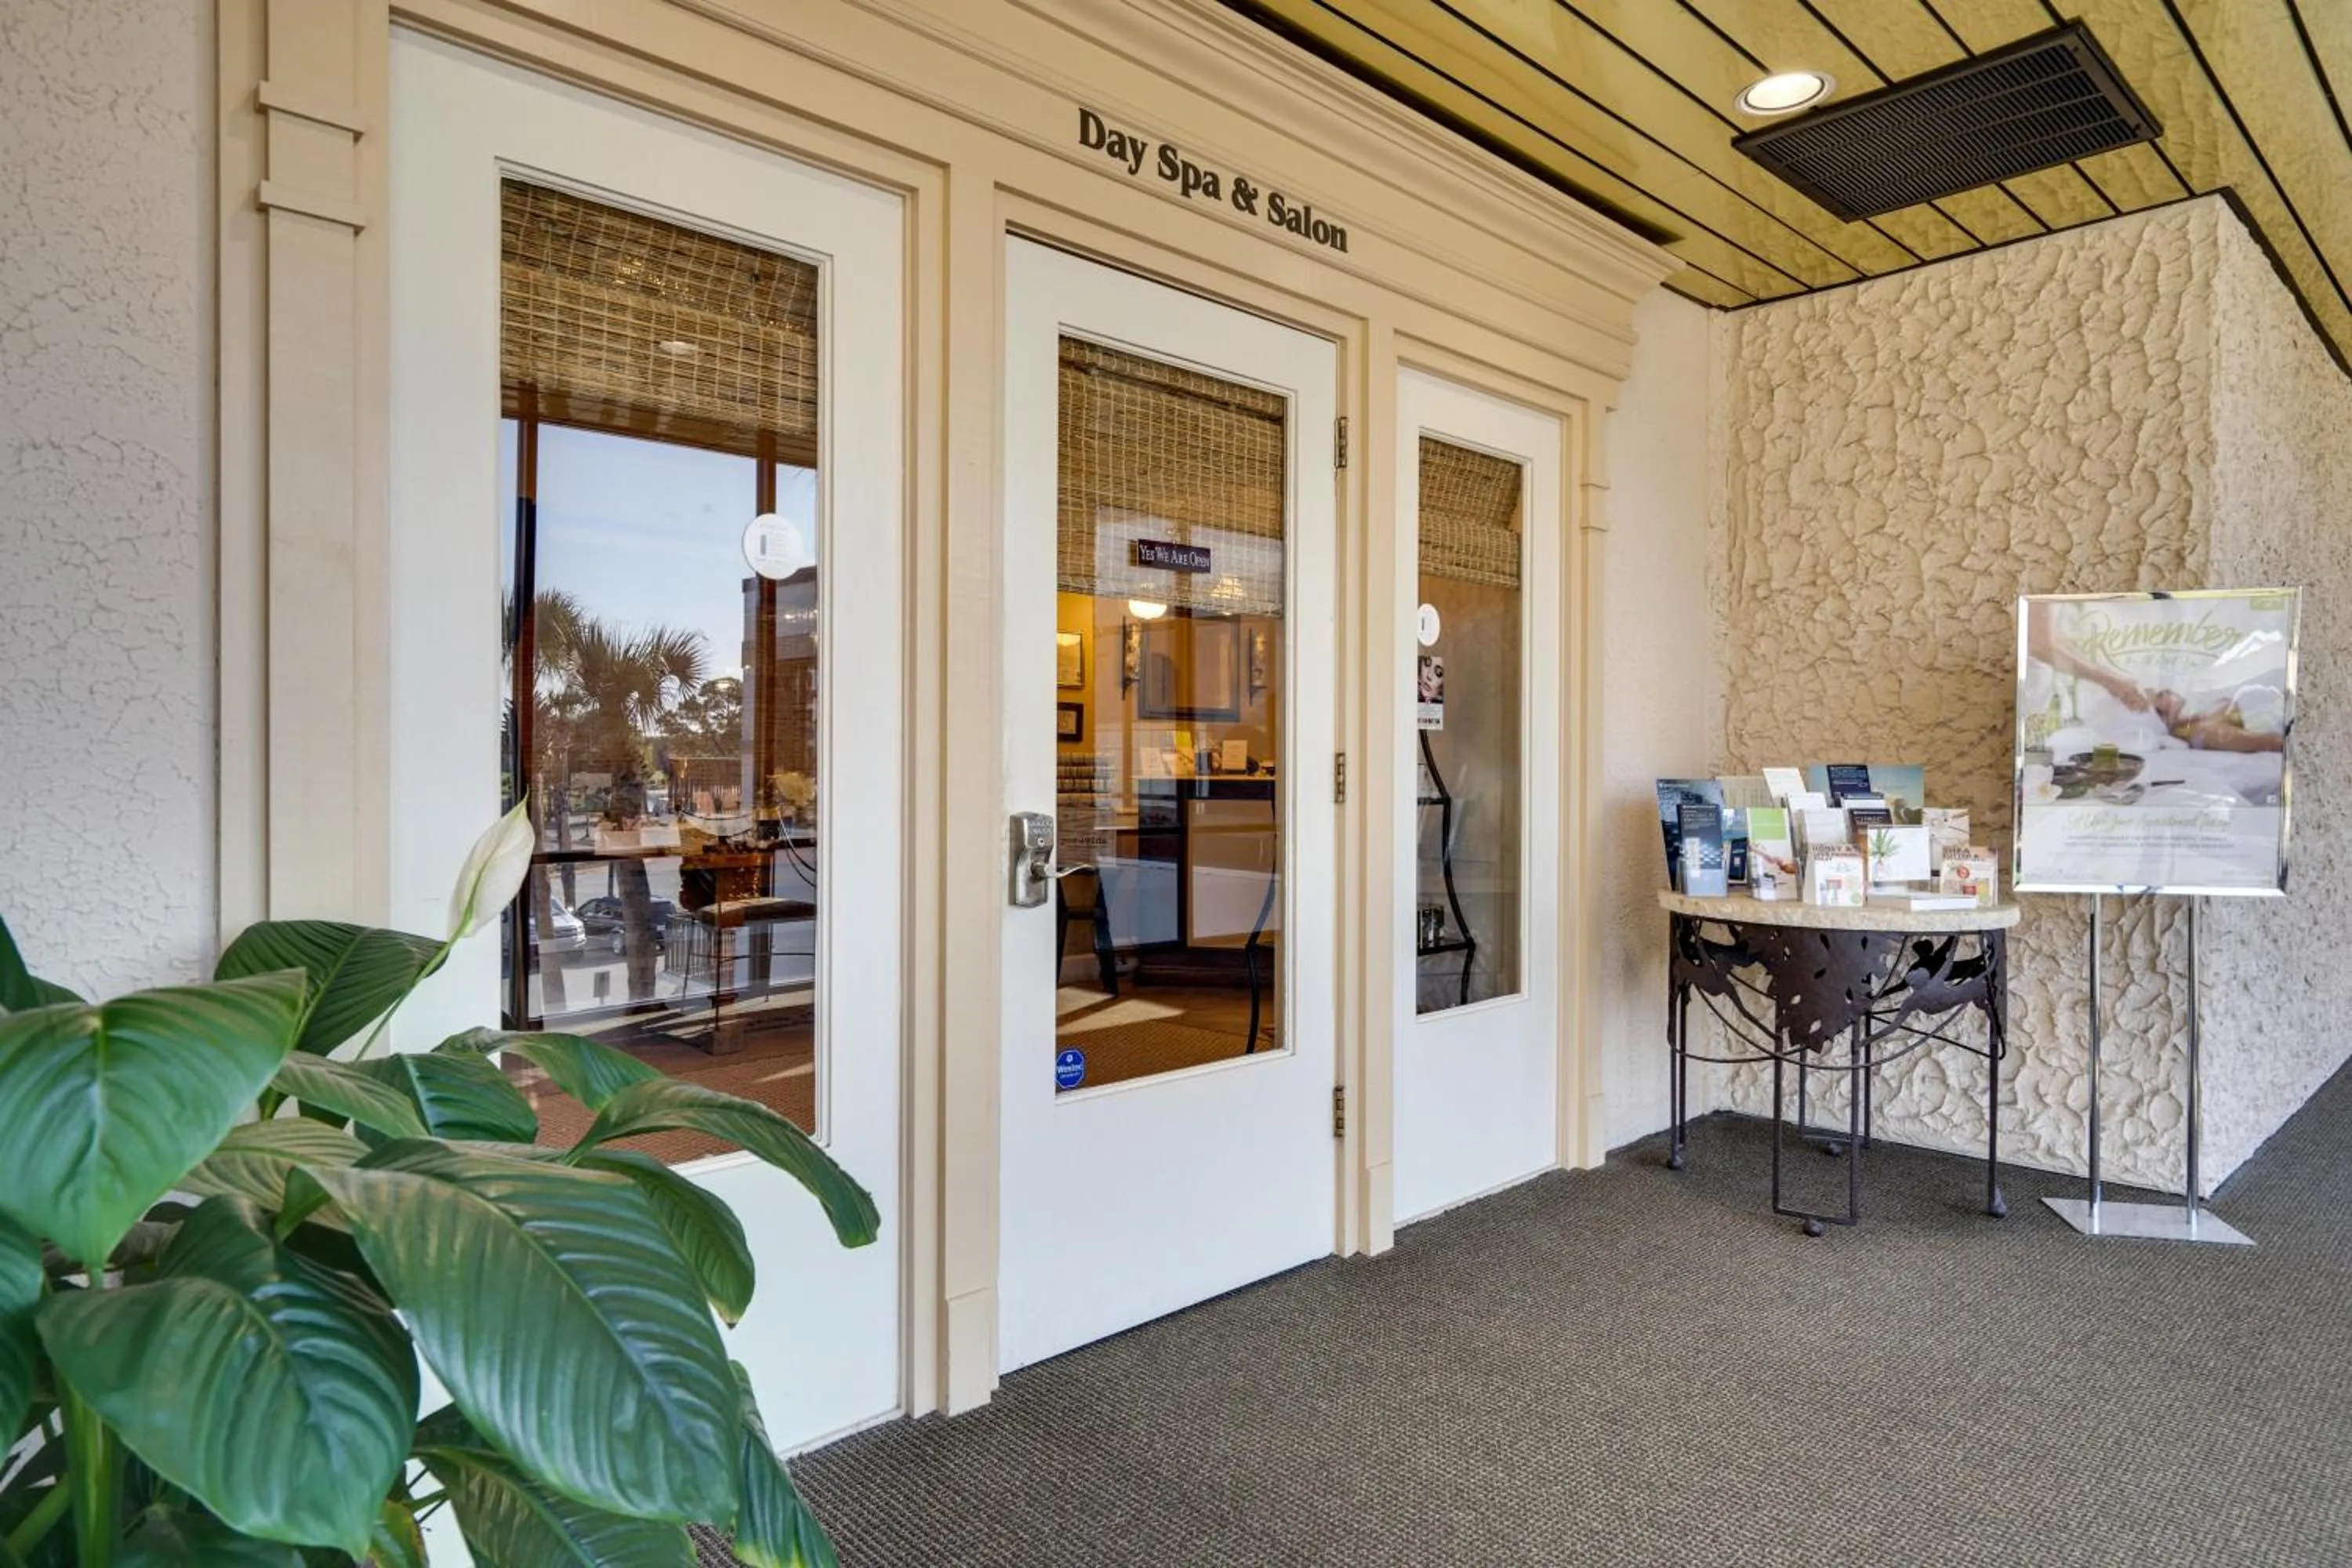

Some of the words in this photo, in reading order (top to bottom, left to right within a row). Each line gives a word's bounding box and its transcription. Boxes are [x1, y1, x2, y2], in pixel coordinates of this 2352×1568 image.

[1078, 107, 1149, 176] Day
[1157, 143, 1222, 199] Spa
[1231, 176, 1258, 216] &
[1267, 191, 1348, 253] Salon
[2080, 606, 2242, 667] Remember
